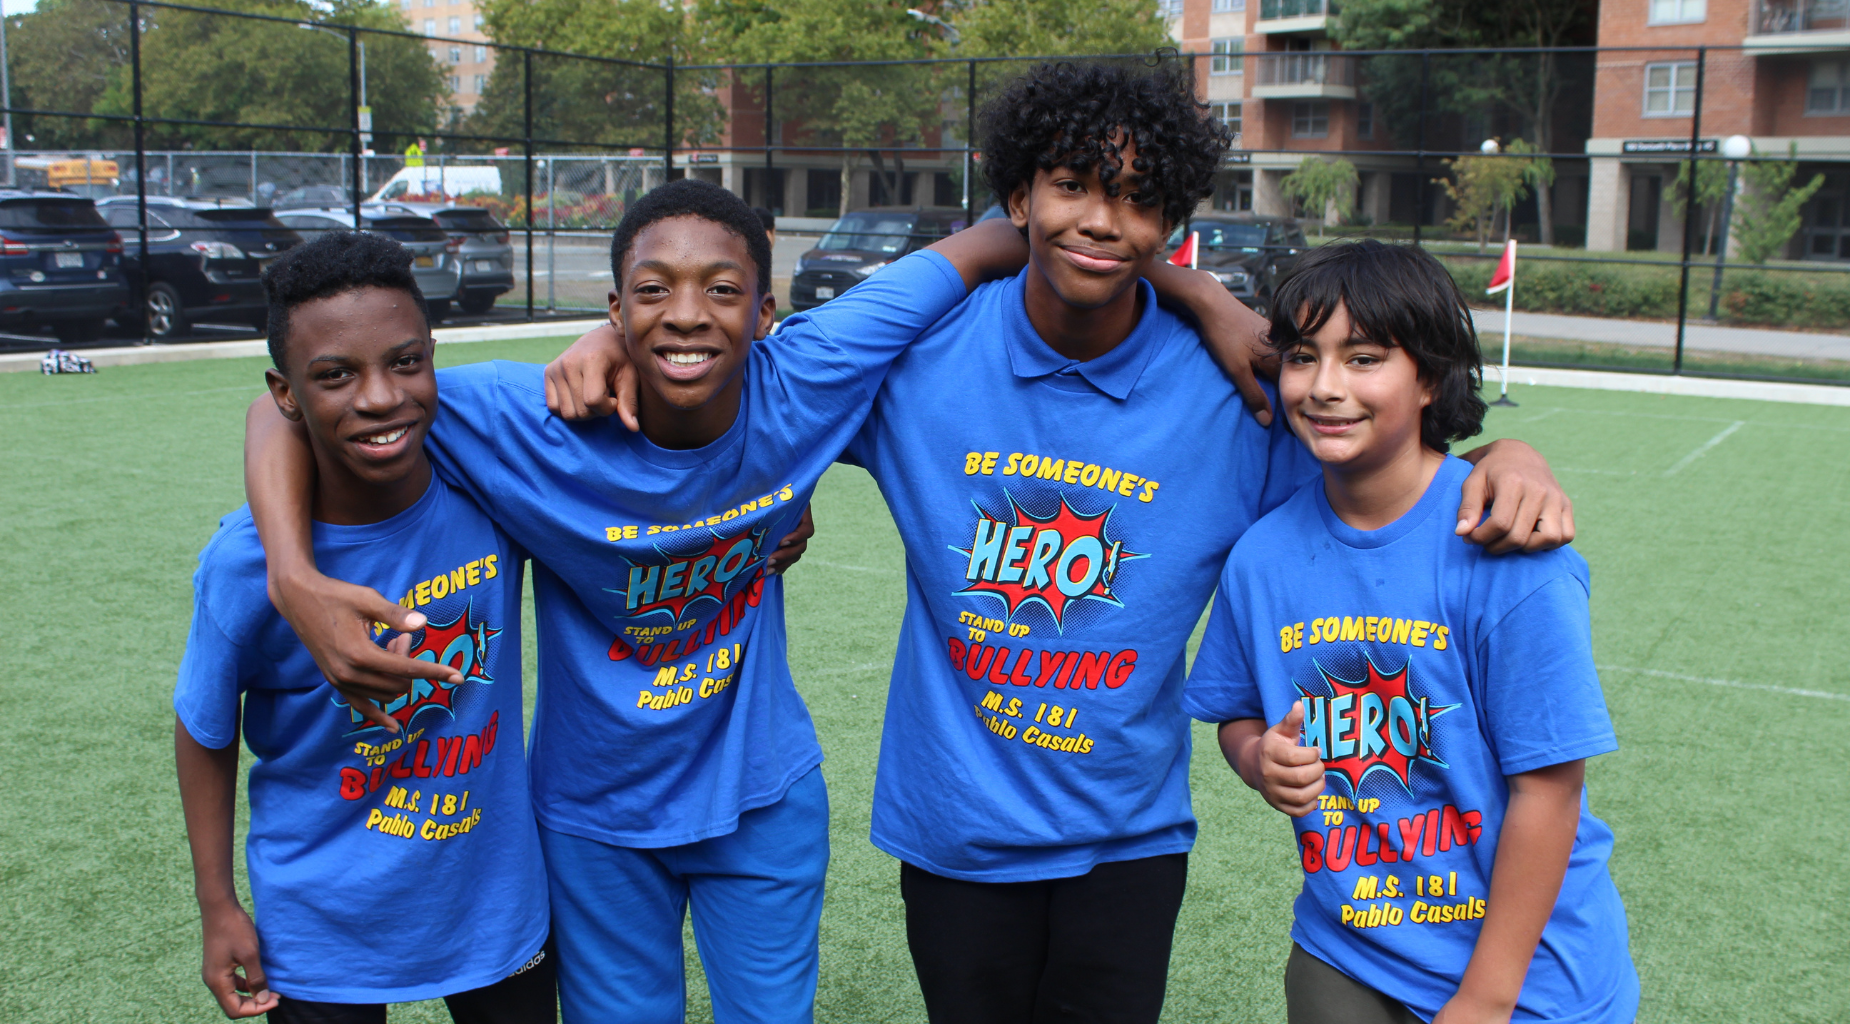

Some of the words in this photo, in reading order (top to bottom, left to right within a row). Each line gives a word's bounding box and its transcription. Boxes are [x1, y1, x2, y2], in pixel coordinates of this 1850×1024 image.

[964, 452, 999, 476] BE
[1003, 453, 1159, 503] SOMEONE'S
[605, 526, 639, 542] BE
[626, 527, 767, 610] HERO!
[965, 518, 1122, 598] HERO!
[373, 554, 498, 636] MEONE'S
[624, 626, 673, 636] STAND
[677, 618, 697, 631] UP
[635, 636, 655, 644] TO
[958, 610, 1005, 633] STAND
[1008, 622, 1031, 638] UP
[968, 627, 987, 643] TO
[1280, 622, 1304, 653] BE
[1309, 616, 1449, 651] SOMEONE'S
[652, 663, 698, 687] M.S.
[706, 643, 741, 673] 181
[948, 636, 1138, 690] BULLYING
[637, 685, 693, 710] Pablo
[699, 671, 735, 699] Cas
[981, 690, 1023, 719] M.S.
[1034, 702, 1078, 729] 181
[1301, 691, 1432, 760] HERO!
[354, 741, 403, 757] STAND
[407, 728, 425, 744] UP
[973, 704, 1017, 740] Pablo
[1022, 725, 1095, 754] Casals
[339, 710, 499, 800] BULLYING
[366, 754, 386, 767] TO
[384, 785, 421, 813] M.S.
[430, 790, 470, 816] 181
[1315, 794, 1355, 811] TAND
[1358, 797, 1380, 814] UP
[365, 808, 416, 839] Pablo
[420, 808, 482, 841] Casals
[1322, 811, 1344, 826] TO
[1300, 804, 1482, 874] BULLYING
[1352, 874, 1404, 900] M.S.
[1416, 871, 1457, 897] 181
[1341, 902, 1404, 929] Pablo
[1409, 896, 1487, 924] Casals
